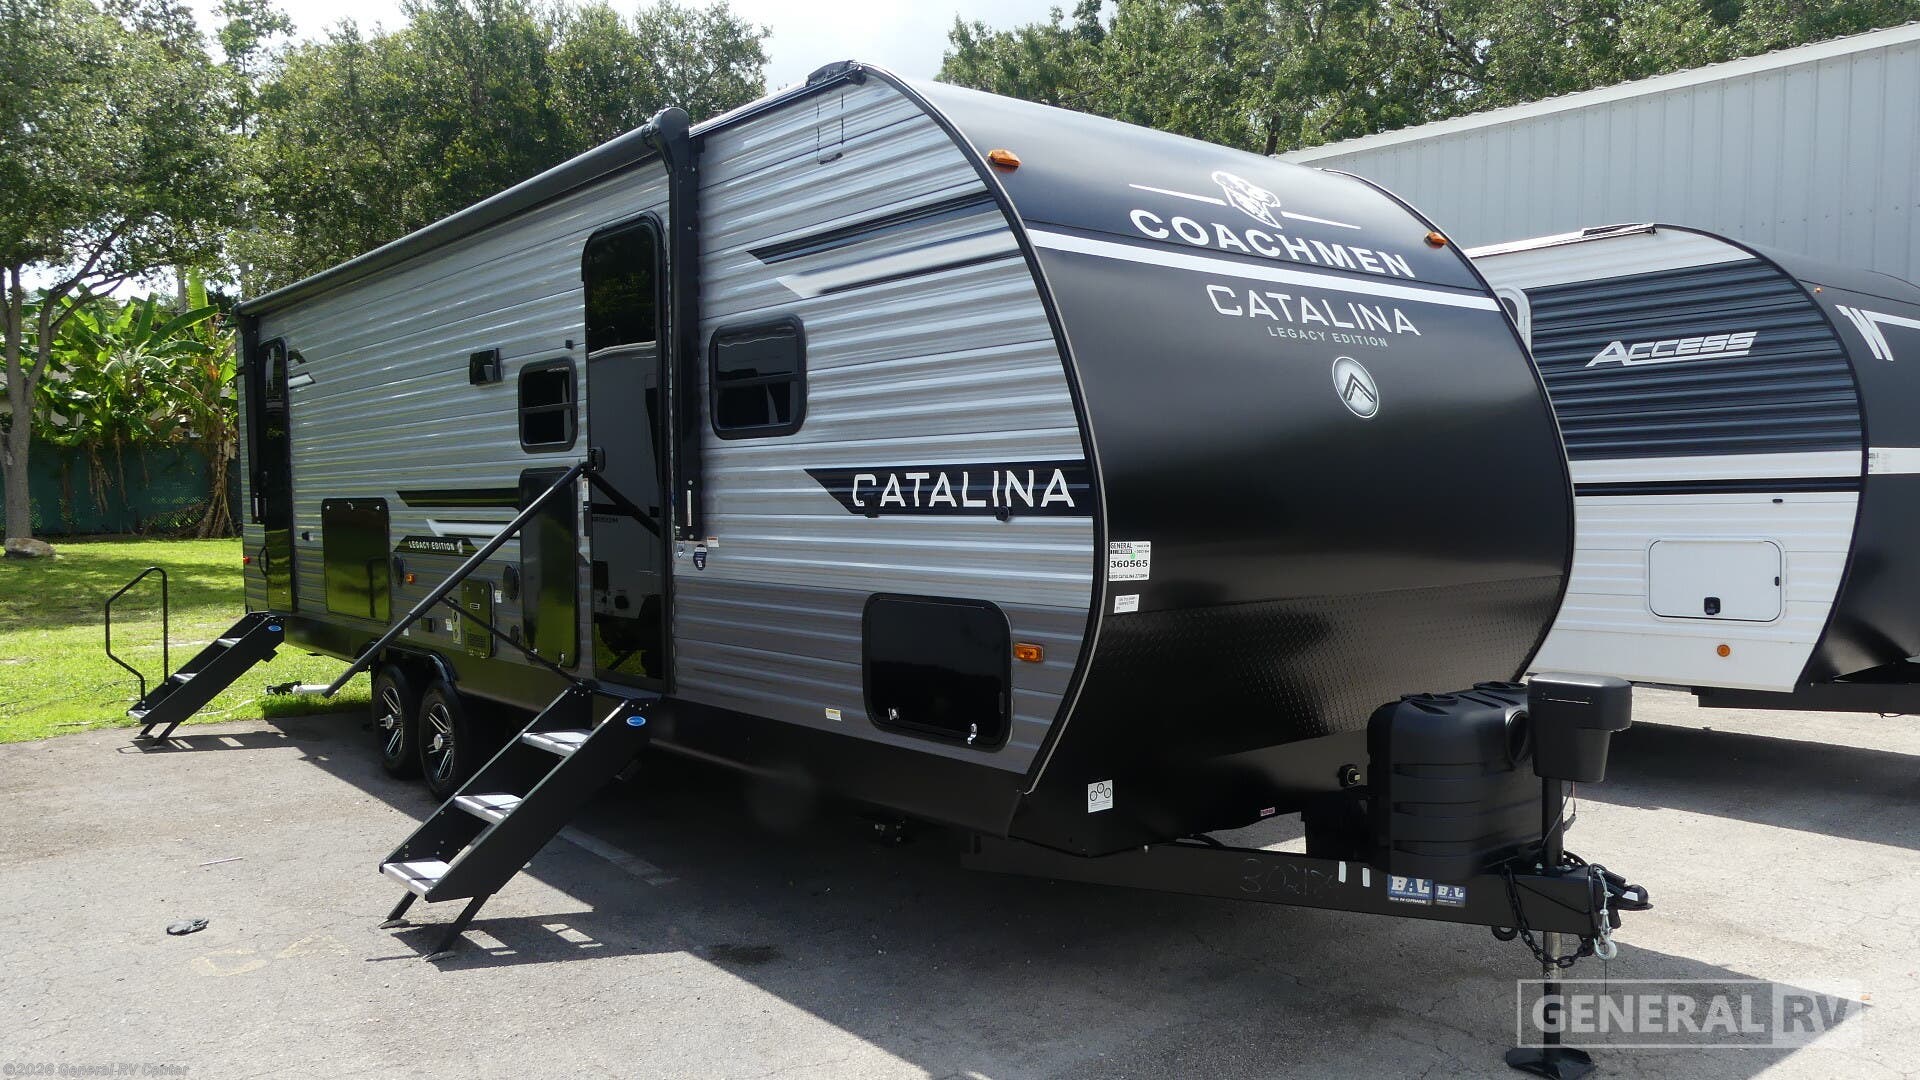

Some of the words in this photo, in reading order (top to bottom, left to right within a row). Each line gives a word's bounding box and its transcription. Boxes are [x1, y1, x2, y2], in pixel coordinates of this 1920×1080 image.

[1129, 209, 1416, 278] COACHMEN
[1206, 284, 1422, 336] CATALINA
[1268, 326, 1326, 342] LEGACY
[1332, 332, 1388, 347] EDITION
[852, 468, 1075, 508] CATALINA
[408, 541, 429, 550] LEGACY
[431, 542, 455, 551] EDITION
[1110, 560, 1148, 568] 360565
[1391, 876, 1430, 893] BAL
[1437, 886, 1464, 898] BAL
